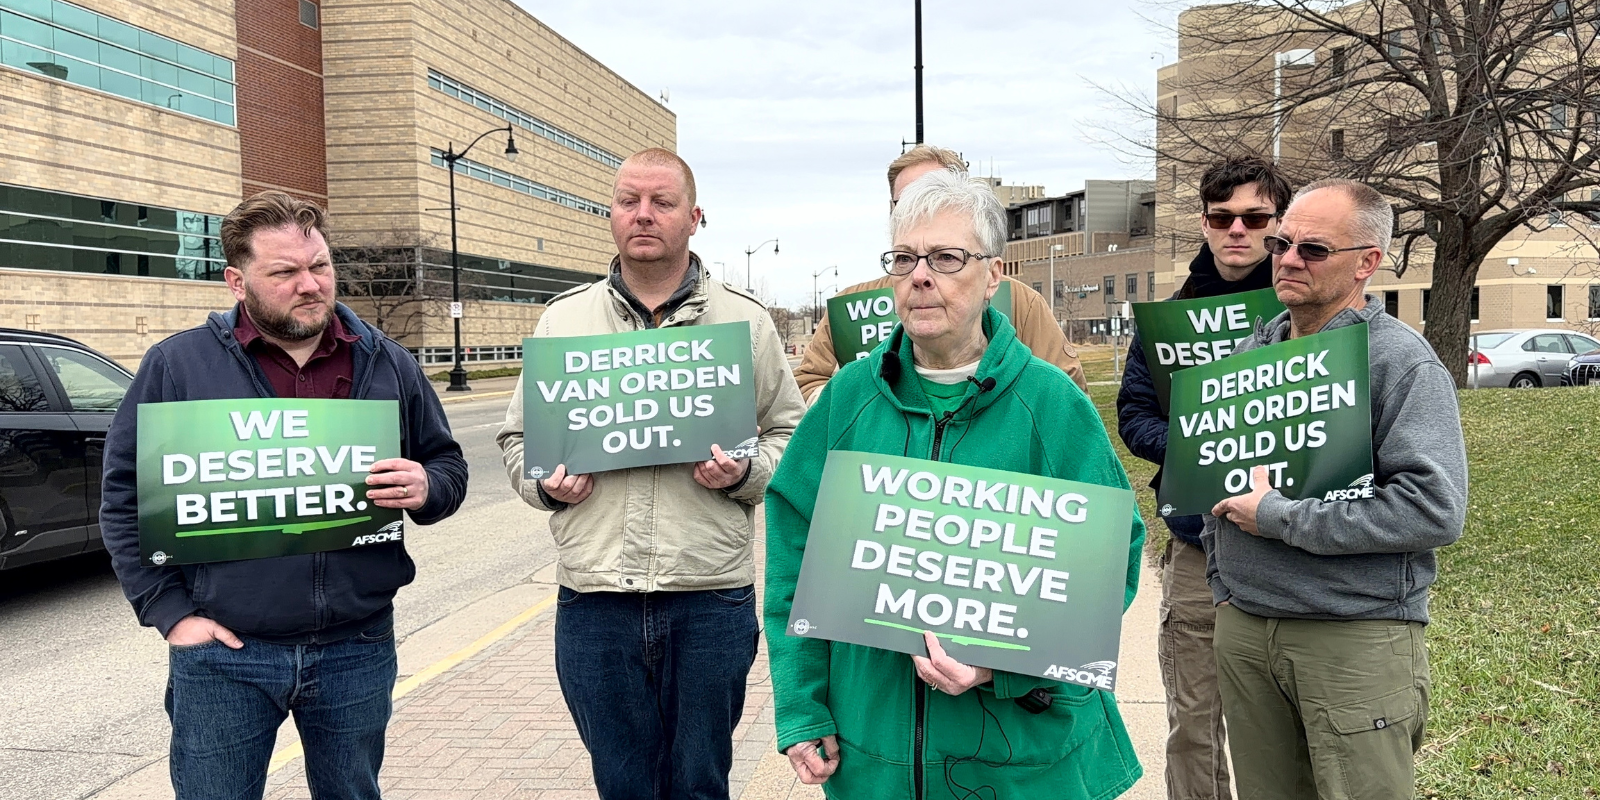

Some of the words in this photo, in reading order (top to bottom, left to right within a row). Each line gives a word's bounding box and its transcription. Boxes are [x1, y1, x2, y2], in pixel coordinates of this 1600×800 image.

[846, 296, 897, 321] WO
[1186, 303, 1250, 334] WE
[565, 339, 714, 373] DERRICK
[1155, 338, 1246, 366] DESE
[536, 377, 610, 403] VAN
[620, 364, 740, 394] ORDEN
[1201, 349, 1329, 404] DERRICK
[229, 409, 309, 440] WE
[568, 398, 659, 431] SOLD
[669, 394, 714, 418] US
[1179, 405, 1235, 438] VAN
[1243, 380, 1356, 426] ORDEN
[602, 425, 681, 454] OUT.
[1198, 430, 1276, 466] SOLD
[1284, 420, 1327, 451] US
[162, 445, 377, 485] DESERVE
[176, 484, 367, 526] BETTER.
[861, 463, 1089, 523] WORKING
[1323, 486, 1374, 502] AFSCME
[351, 531, 403, 547] AFSCME
[874, 503, 1058, 559] PEOPLE
[851, 539, 1070, 603] DESERVE
[874, 582, 1029, 639] MORE.
[1043, 664, 1113, 690] AFSCME
